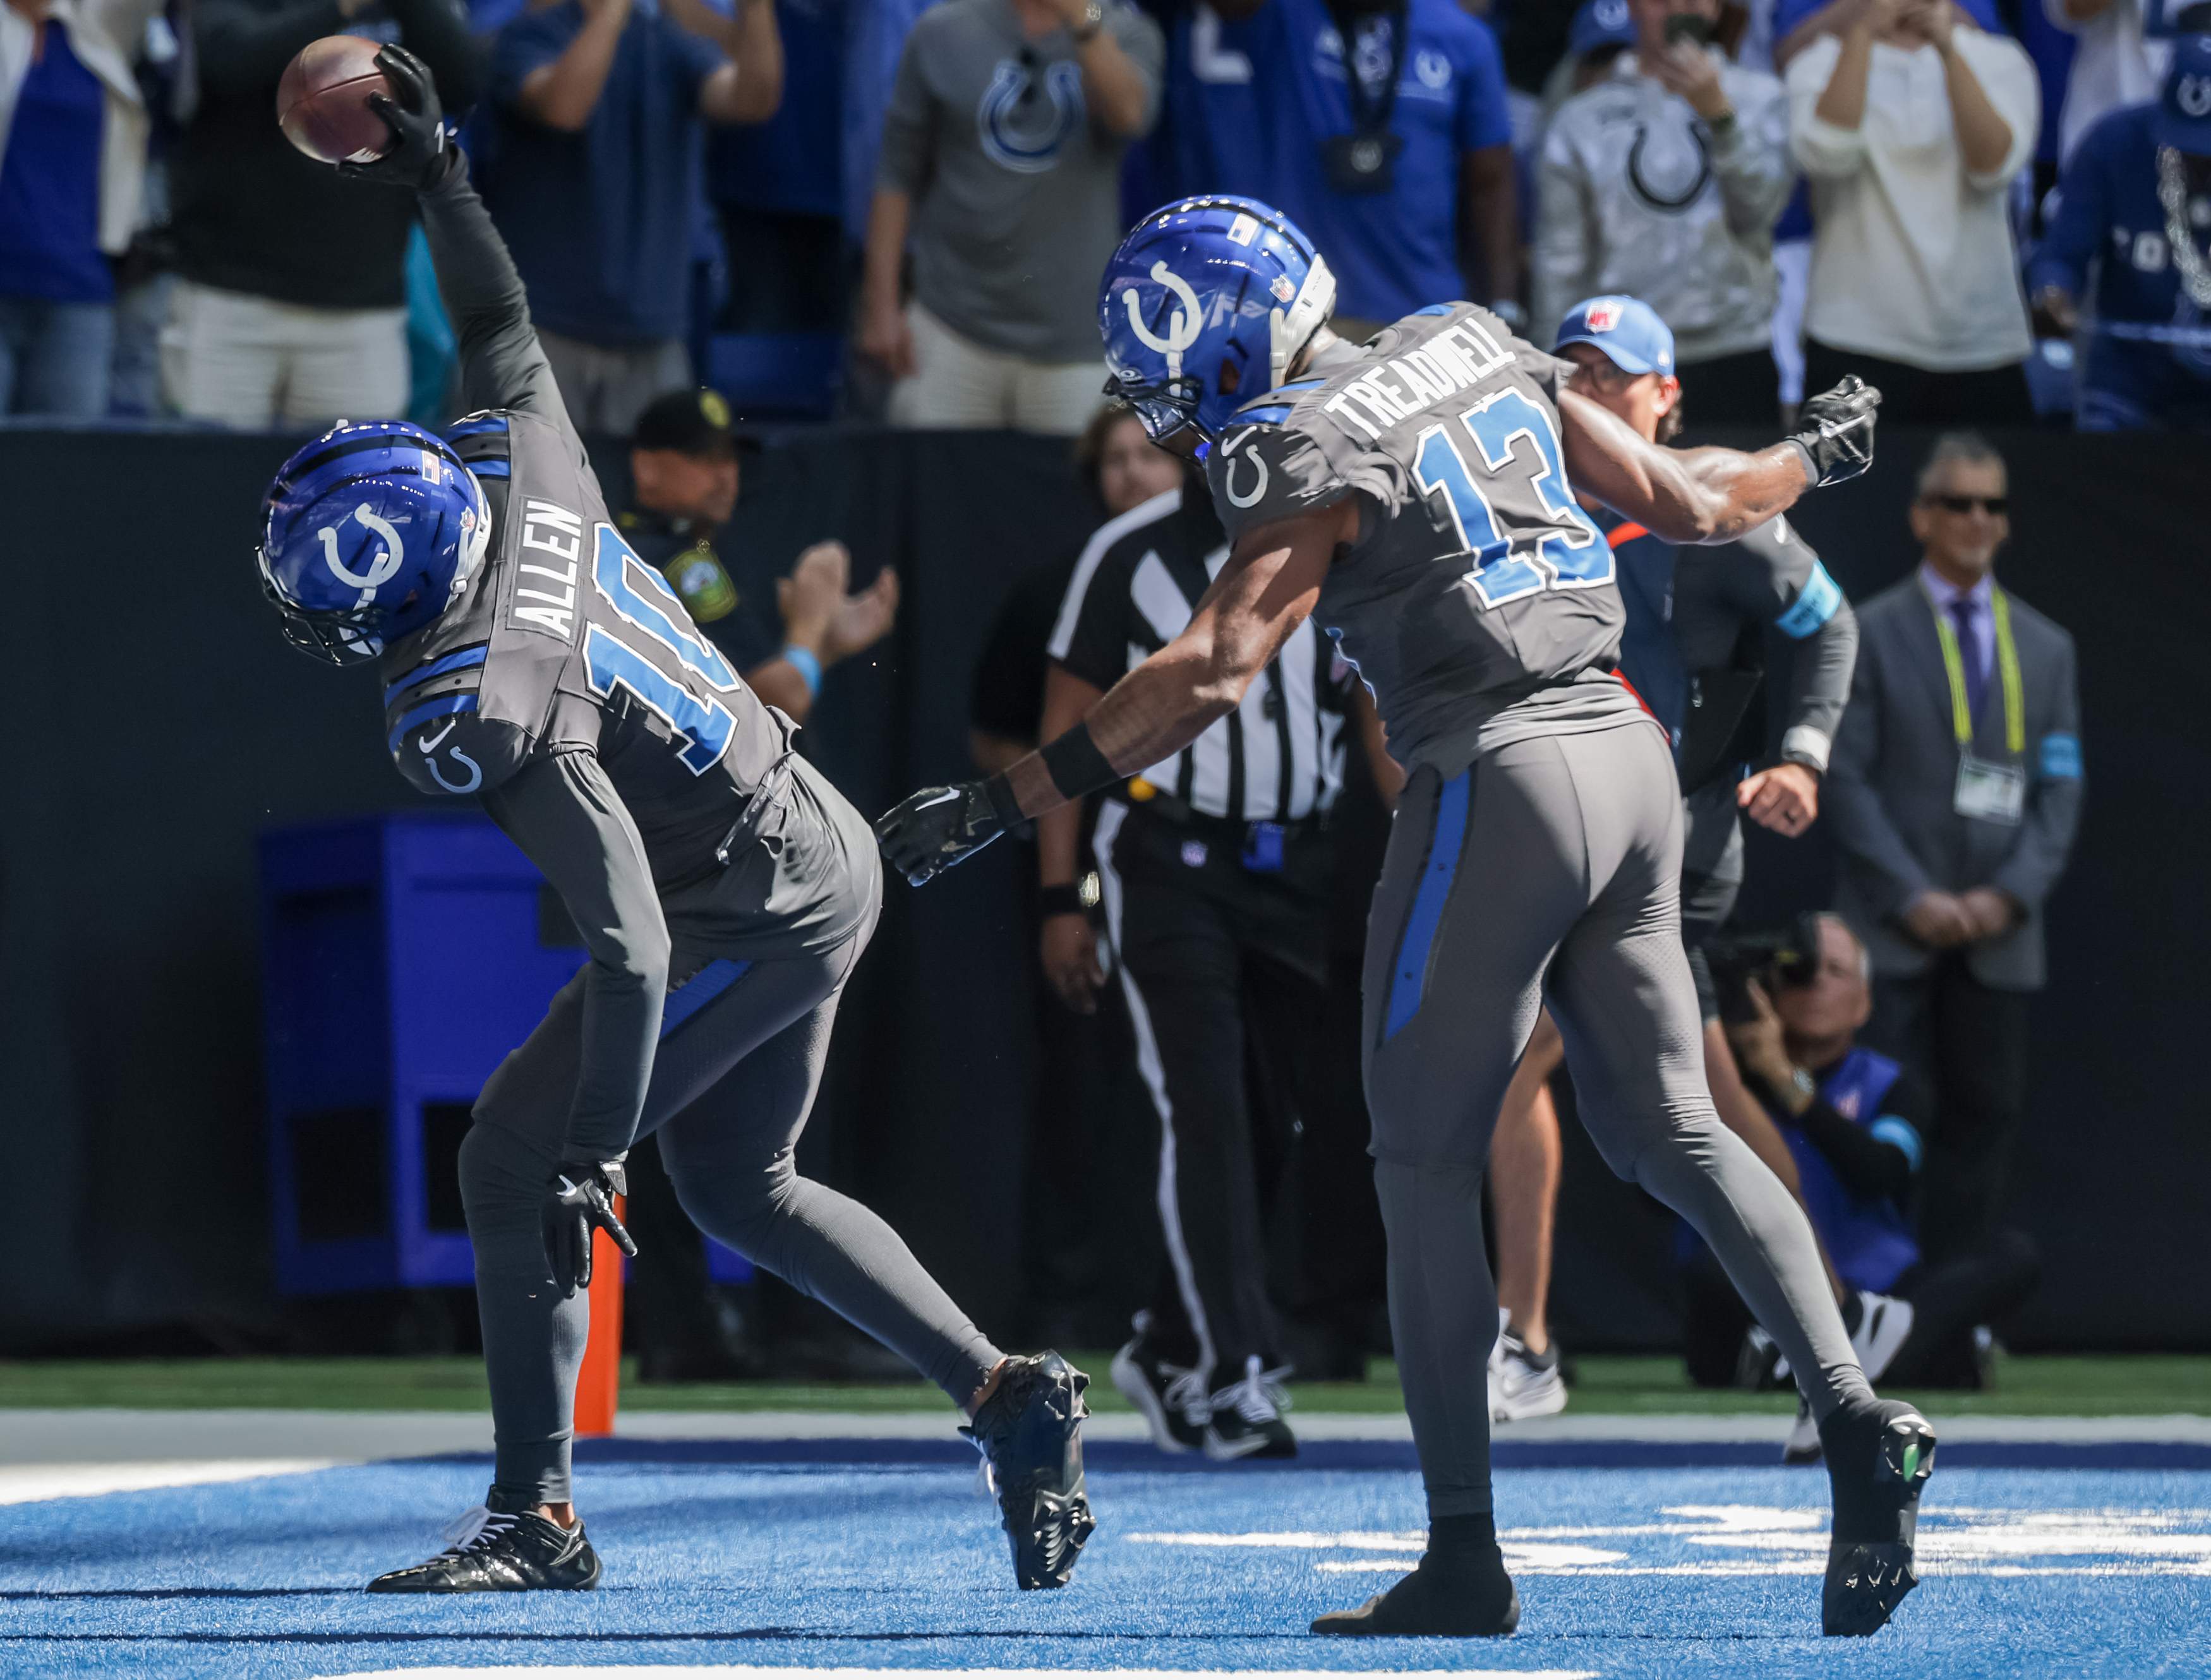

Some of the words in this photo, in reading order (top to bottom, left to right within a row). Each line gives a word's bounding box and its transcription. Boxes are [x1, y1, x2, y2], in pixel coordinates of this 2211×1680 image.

[1323, 317, 1516, 440] TREADWELL
[515, 500, 582, 639] ALLEN
[1411, 385, 1616, 609] 13
[582, 522, 740, 777] 10
